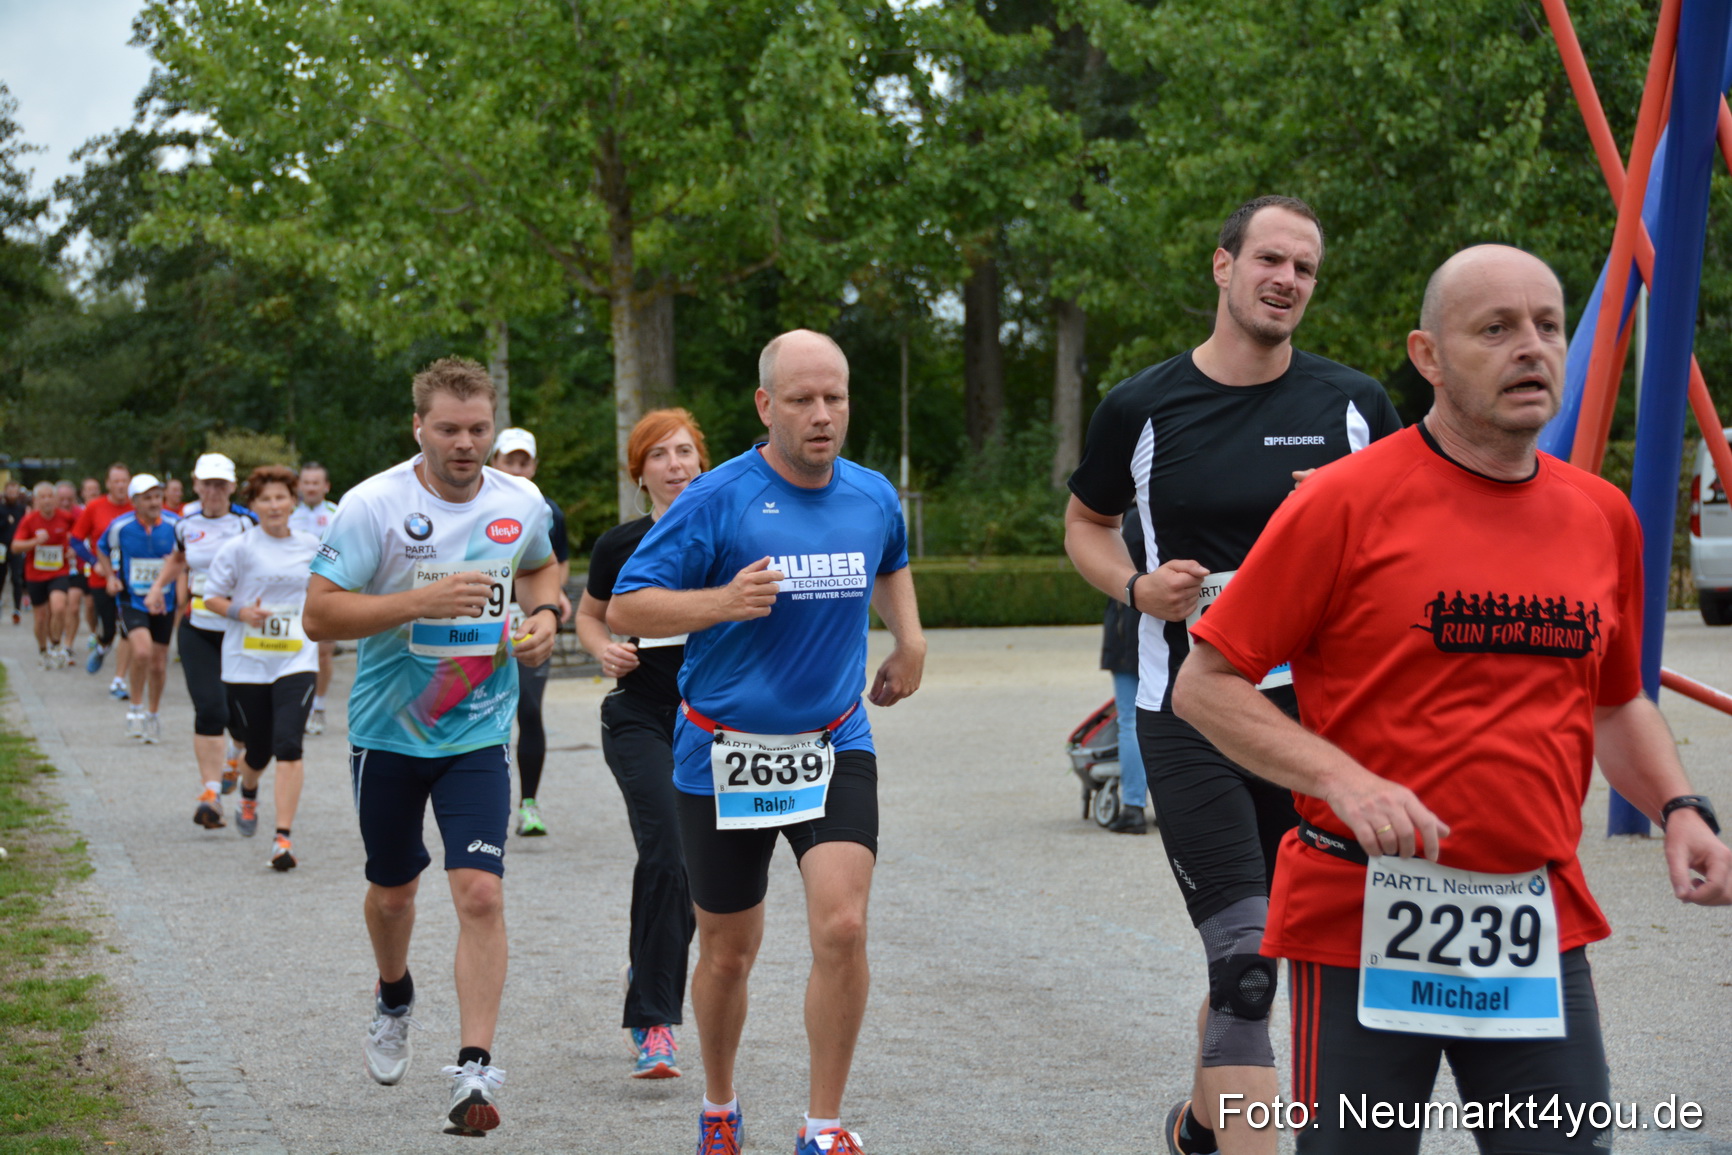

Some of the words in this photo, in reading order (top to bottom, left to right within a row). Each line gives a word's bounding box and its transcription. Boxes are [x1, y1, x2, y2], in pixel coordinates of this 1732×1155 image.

[1273, 435, 1326, 446] PFLEIDERER
[490, 525, 519, 537] Hervis
[405, 545, 437, 553] PARTL
[405, 552, 437, 560] Neumarkt
[766, 551, 867, 579] HUBER
[791, 577, 864, 589] TECHNOLOGY
[791, 593, 814, 601] WASTE
[815, 592, 840, 600] WATER
[840, 590, 864, 599] Solutions
[449, 628, 479, 643] Rudi
[1441, 622, 1485, 644] RUN
[1491, 620, 1526, 645] FOR
[1529, 622, 1585, 650] BÜRNI
[724, 751, 823, 787] 2639
[753, 796, 796, 815] Ralph
[480, 843, 502, 857] asics
[1372, 871, 1438, 893] PARTL
[1443, 879, 1524, 895] Neumarkt
[1384, 900, 1542, 968] 2239
[1411, 980, 1509, 1011] Michael
